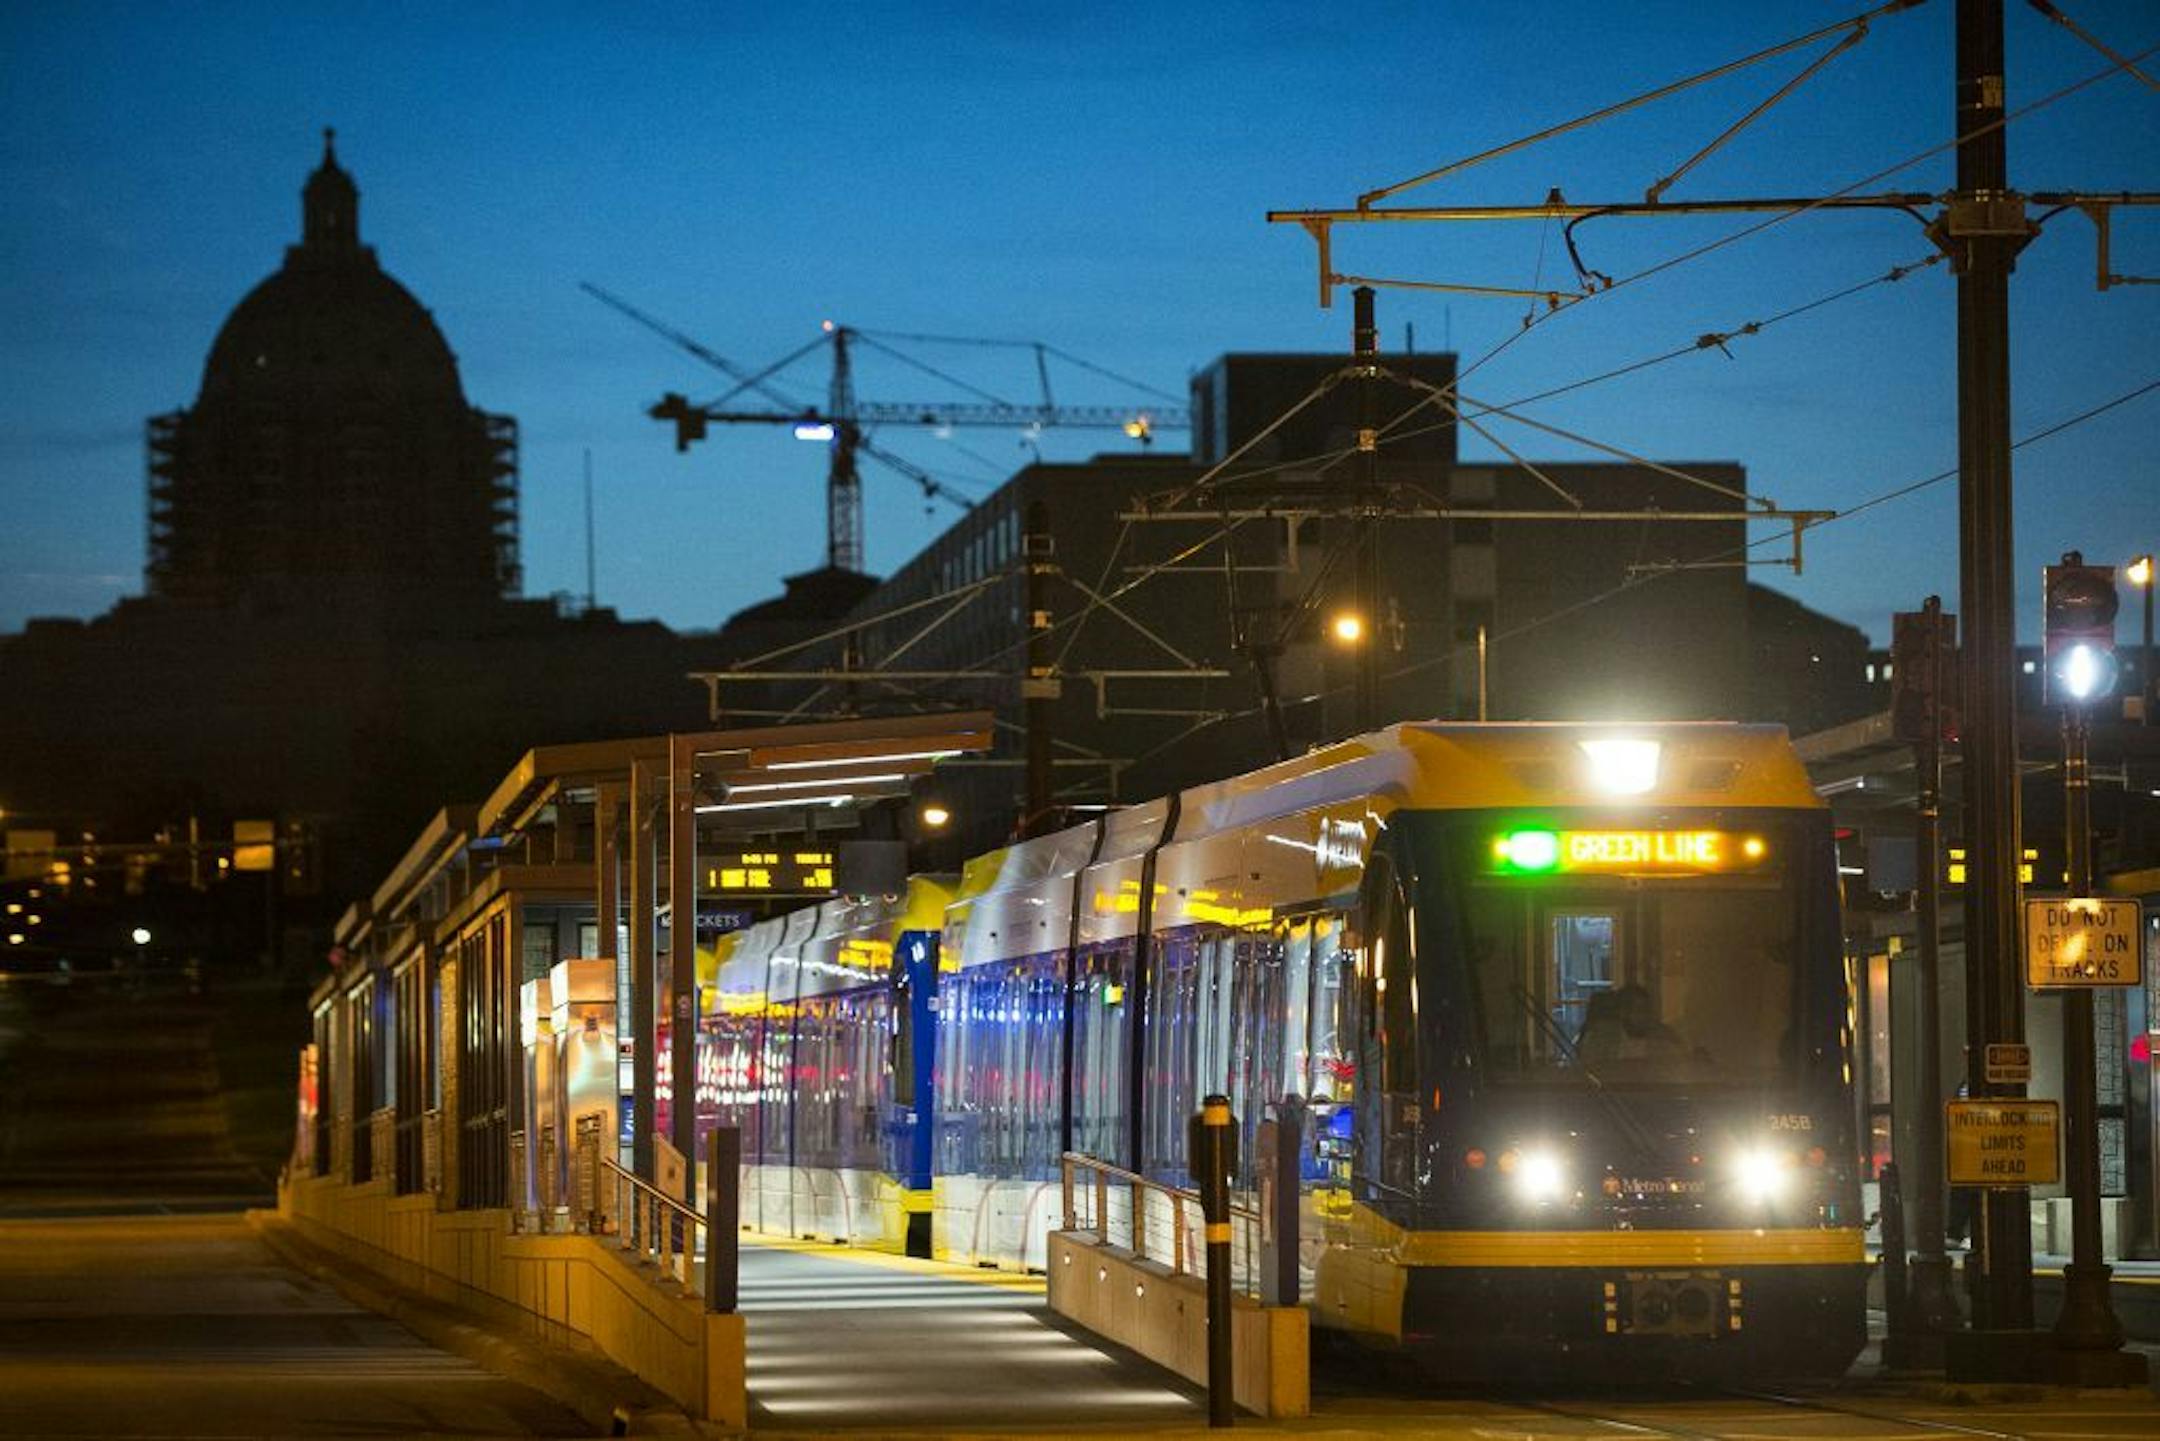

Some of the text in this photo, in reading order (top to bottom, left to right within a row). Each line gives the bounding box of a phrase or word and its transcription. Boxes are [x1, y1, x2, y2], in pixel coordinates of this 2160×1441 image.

[1570, 832, 1719, 862] GREEN LINE
[697, 914, 740, 927] CKETS
[2083, 907, 2118, 927] NOT
[2104, 933, 2128, 953] ON
[2050, 959, 2119, 979] TRACKS
[1980, 1135, 2026, 1151] LIMITS
[1982, 1158, 2026, 1174] AHEAD
